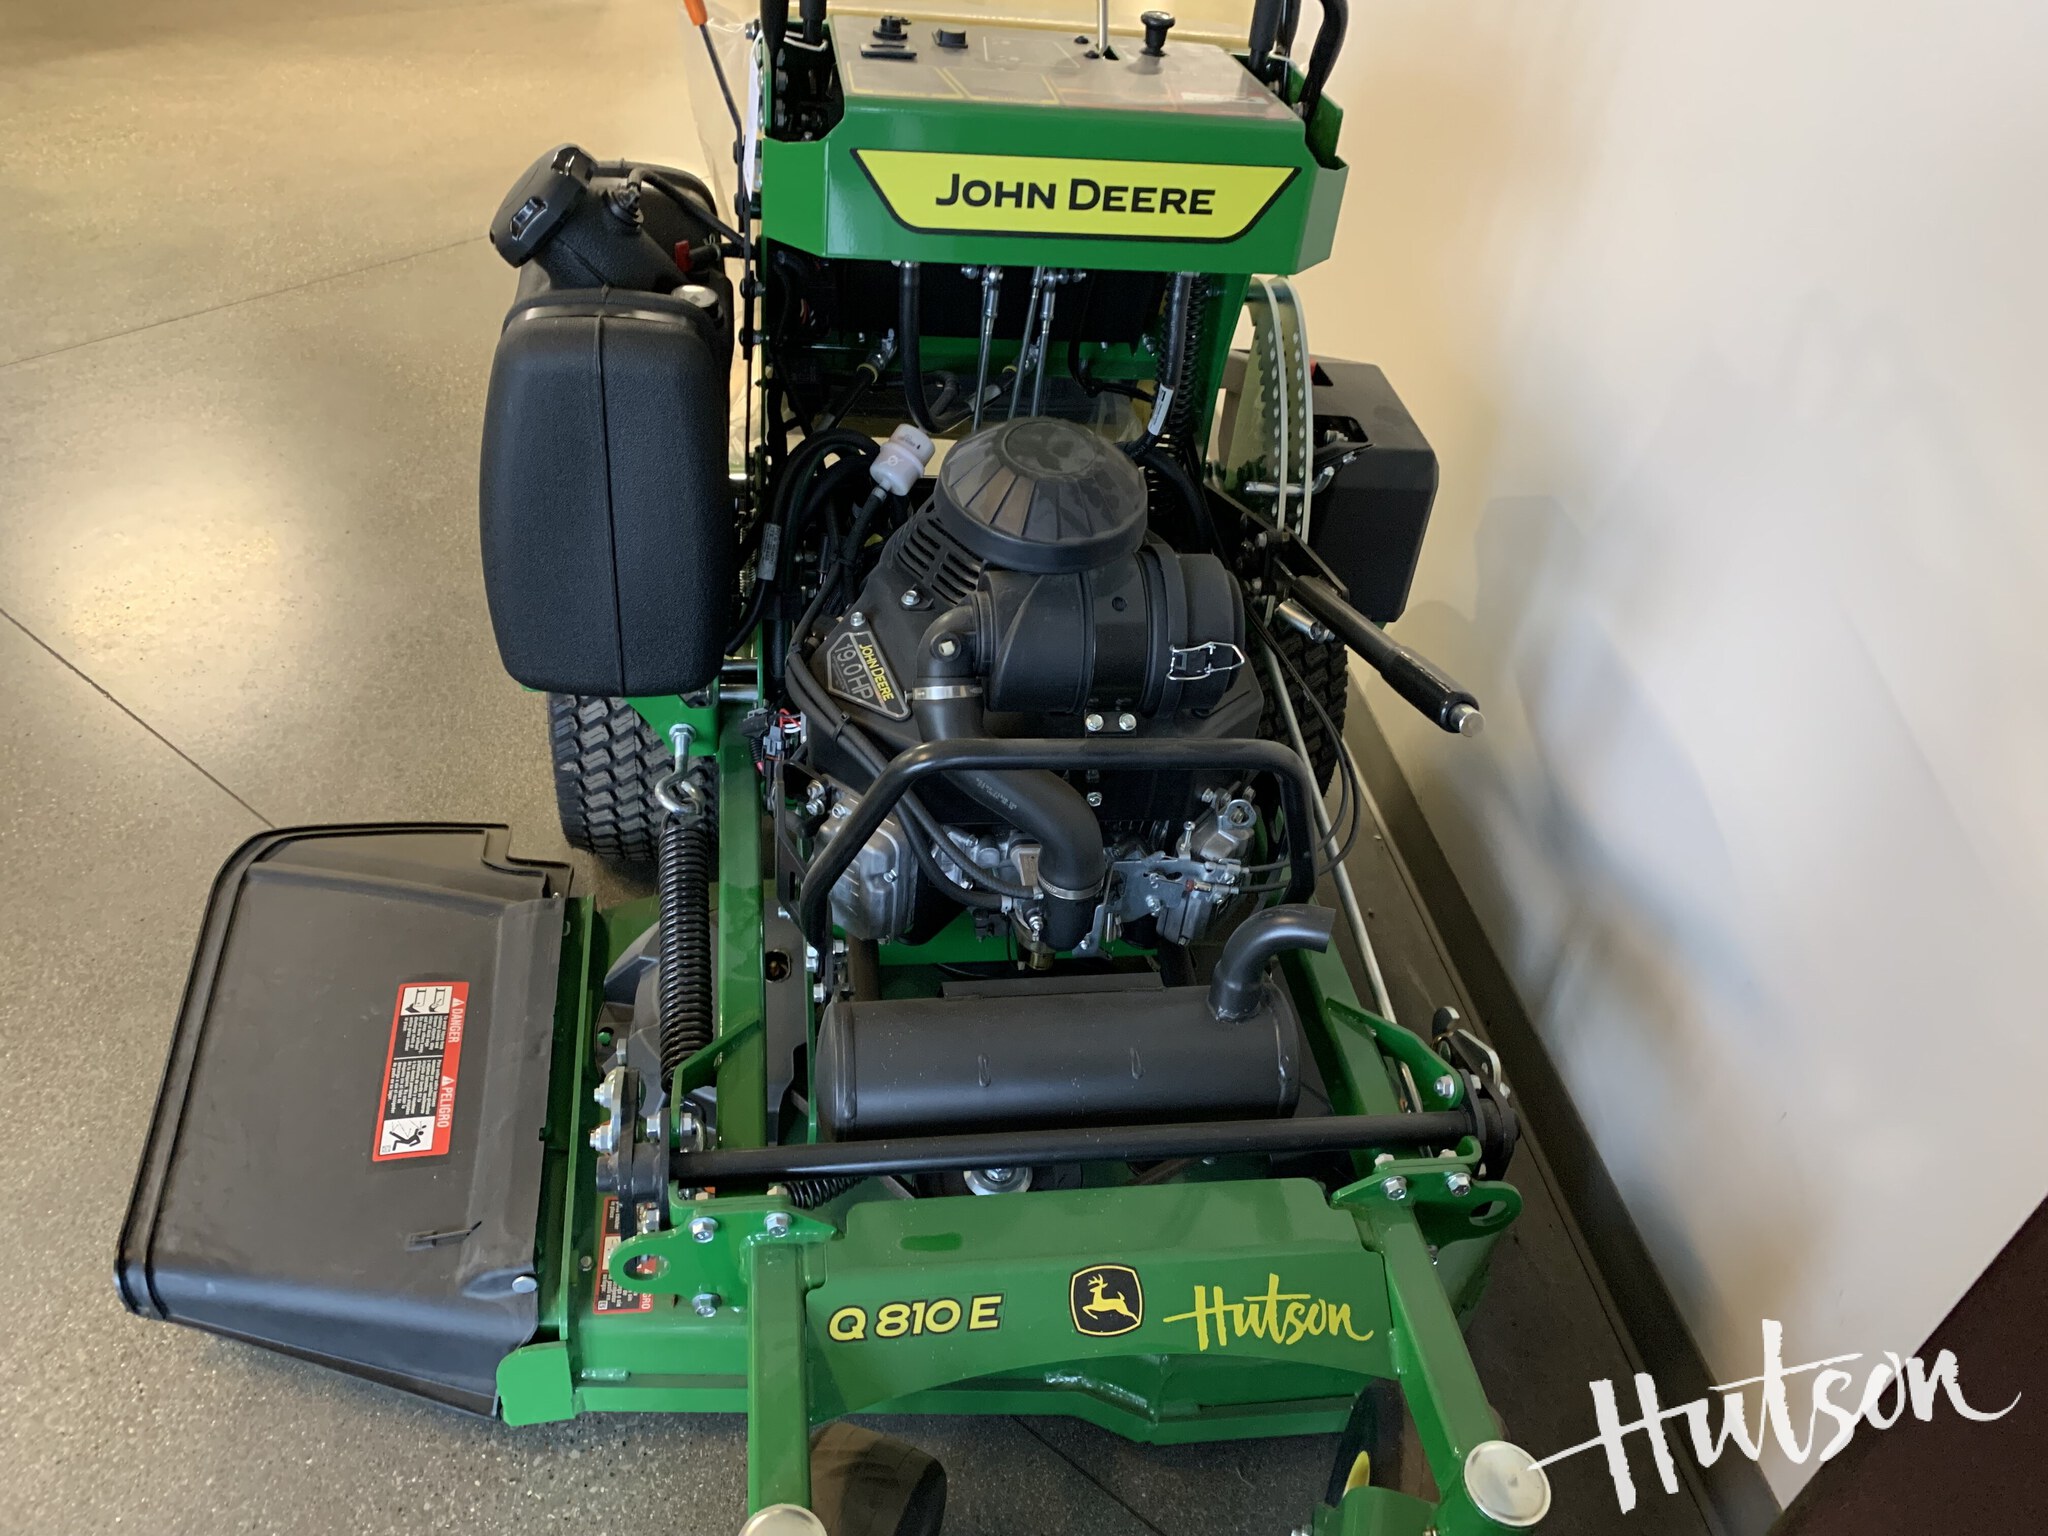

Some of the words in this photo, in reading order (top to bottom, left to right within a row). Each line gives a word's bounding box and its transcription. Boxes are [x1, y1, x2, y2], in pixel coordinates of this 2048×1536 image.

[936, 173, 1057, 209] JOHN
[1069, 178, 1216, 215] DEERE
[835, 643, 863, 675] 19.0
[859, 644, 878, 669] JOHN
[871, 668, 894, 701] DEERE
[848, 676, 874, 698] HP
[448, 1008, 463, 1043] DANGER
[437, 1087, 453, 1128] PELIGRO
[828, 1306, 867, 1342] Q
[875, 1298, 963, 1338] 810
[968, 1294, 1004, 1331] E
[1163, 1273, 1374, 1353] Hutson
